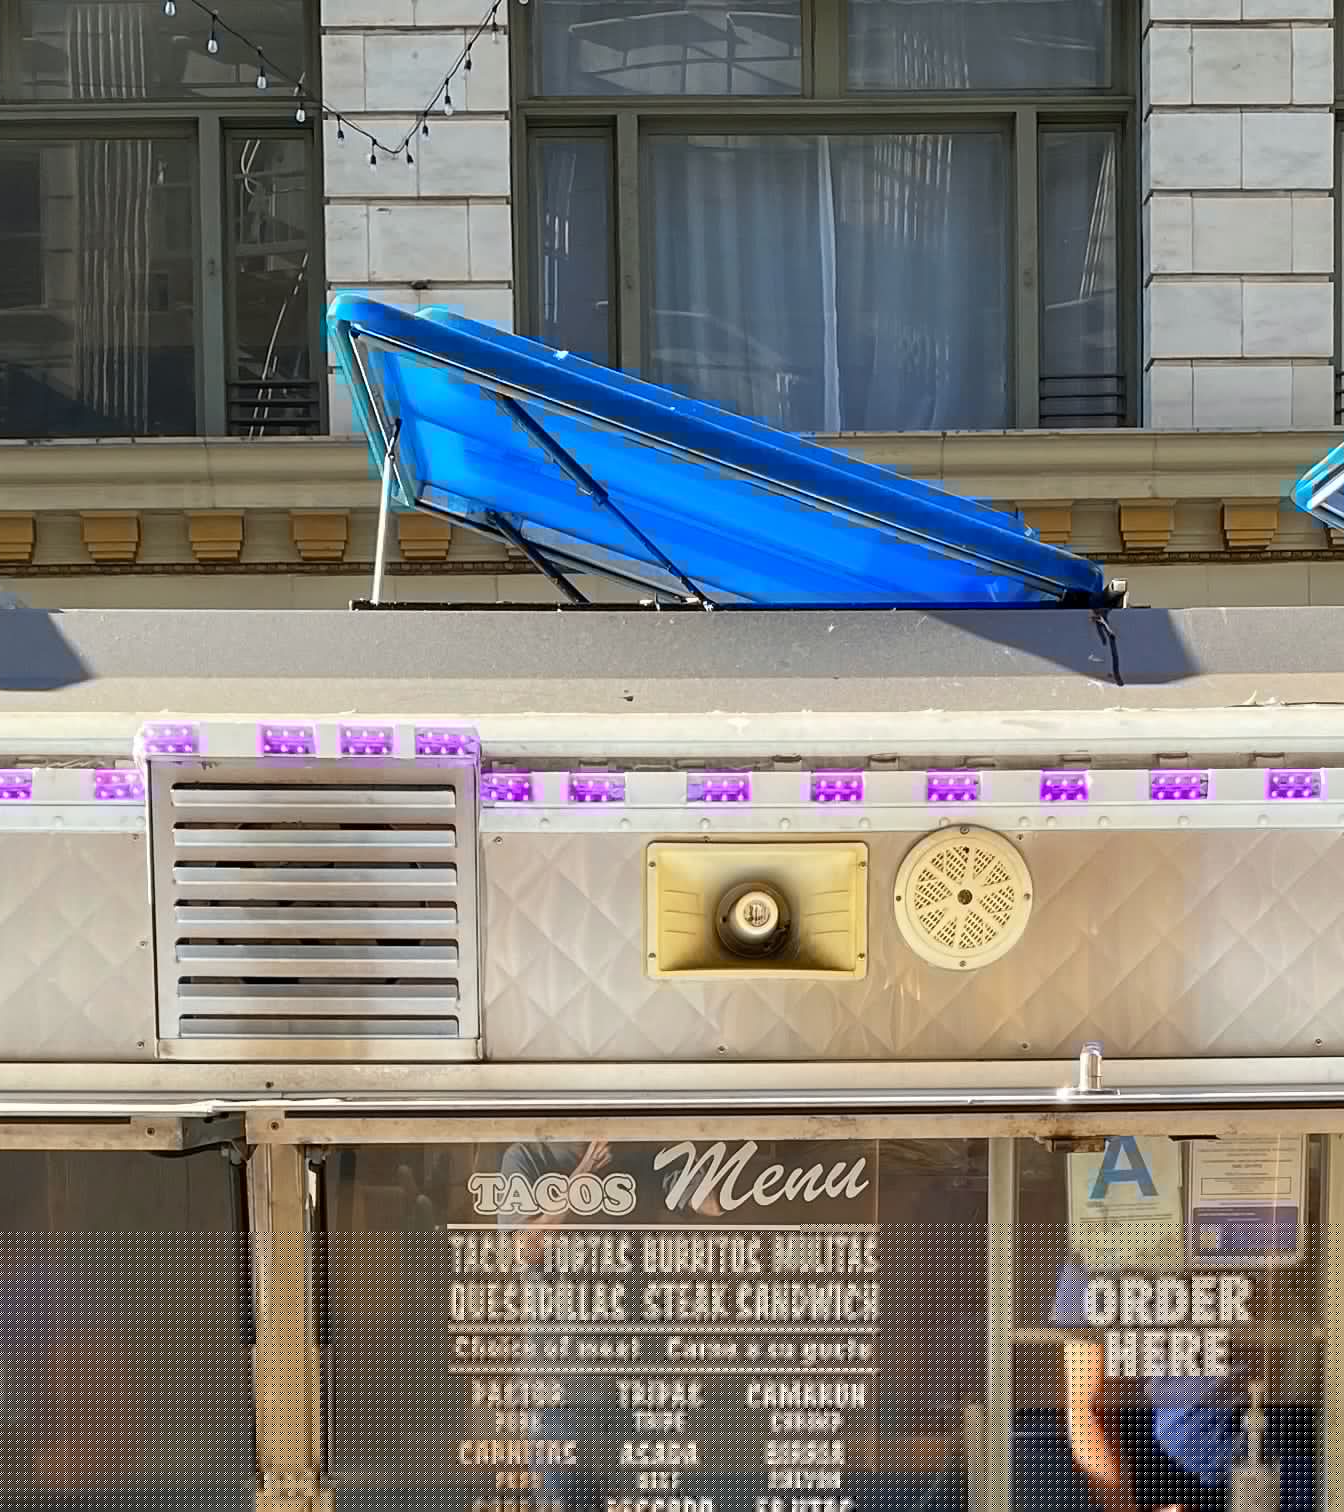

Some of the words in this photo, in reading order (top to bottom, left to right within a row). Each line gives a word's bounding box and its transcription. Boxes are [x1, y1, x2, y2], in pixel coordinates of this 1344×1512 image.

[467, 1172, 638, 1217] TACOS
[653, 1140, 871, 1212] Menu
[1089, 1135, 1160, 1199] A
[642, 1232, 762, 1273] BURRITOS
[448, 1281, 627, 1321] QUESADILLAS
[642, 1281, 729, 1321] STEAK
[735, 1281, 879, 1321] SANDWICH
[1083, 1274, 1254, 1325] ORDER
[1104, 1328, 1230, 1377] HERE
